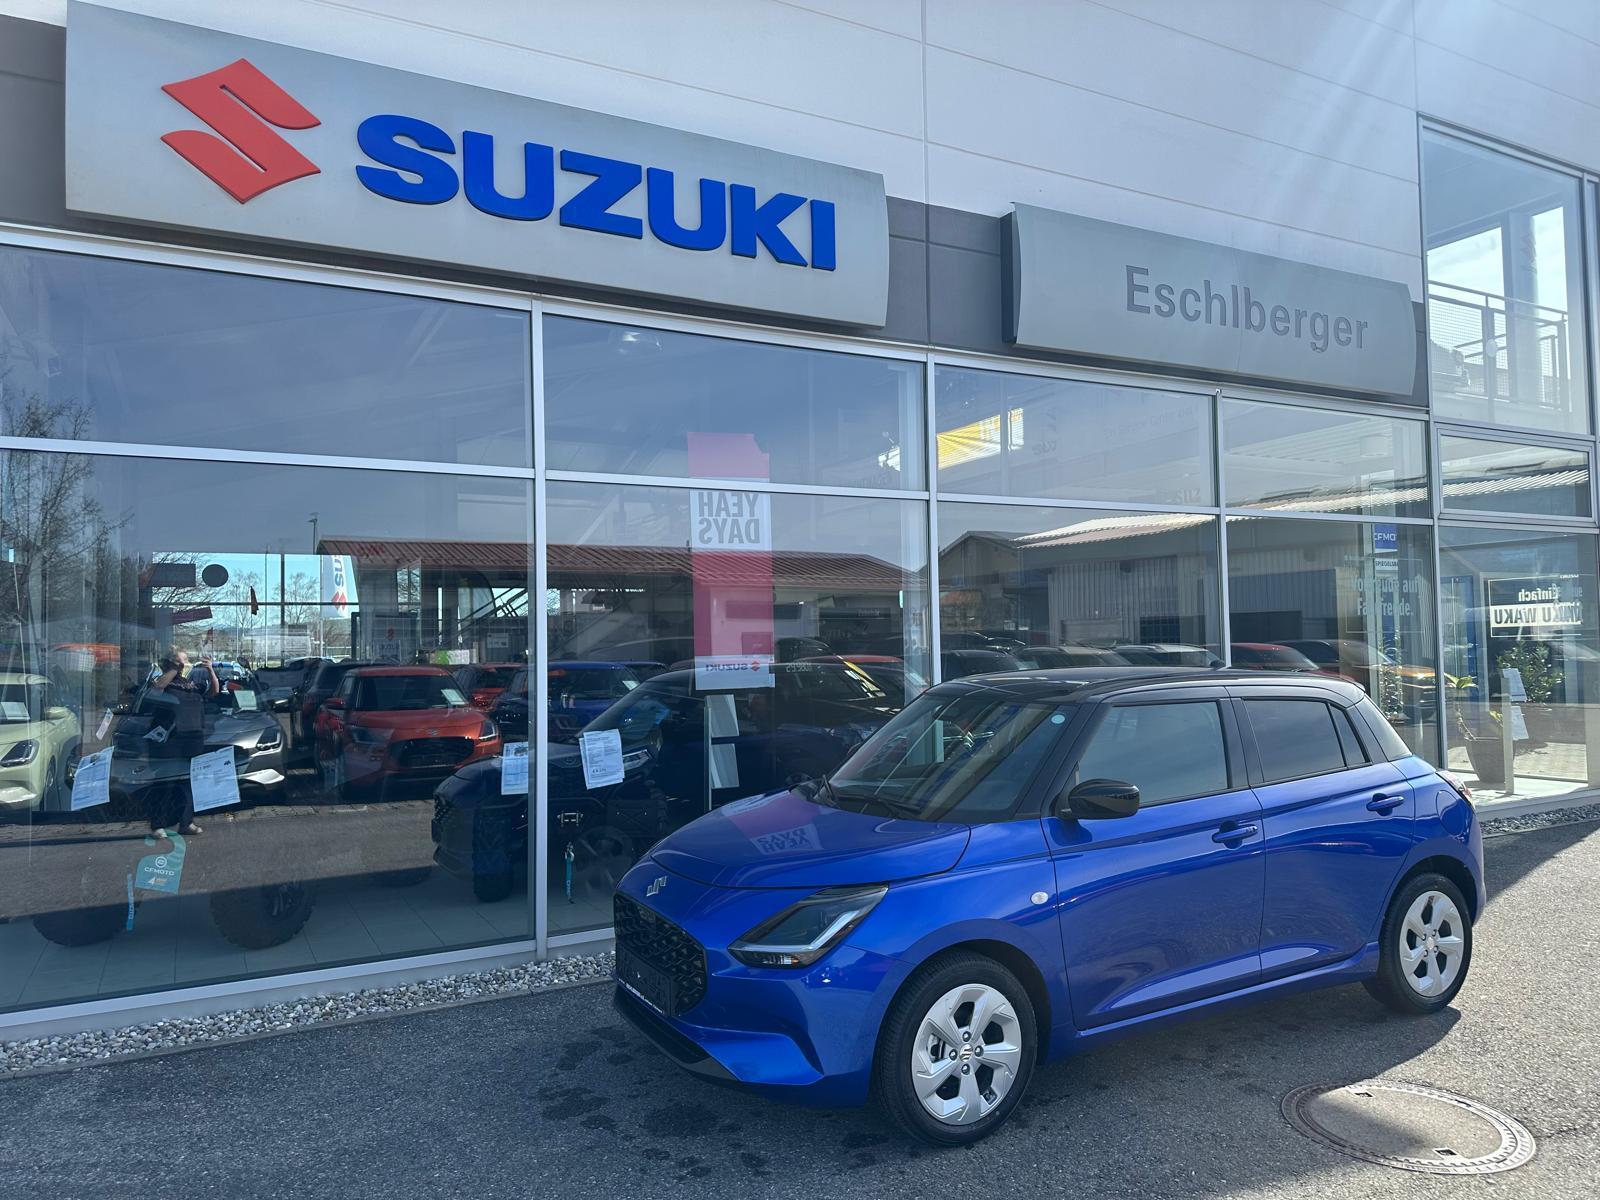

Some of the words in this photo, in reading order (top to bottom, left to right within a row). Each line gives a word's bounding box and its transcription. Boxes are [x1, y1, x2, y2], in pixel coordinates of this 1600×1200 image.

[356, 114, 836, 271] SUZUKI
[1125, 265, 1369, 353] Eschlberger
[1373, 532, 1398, 542] CFMO
[334, 554, 344, 588] SU
[144, 866, 175, 876] CFMOTO
